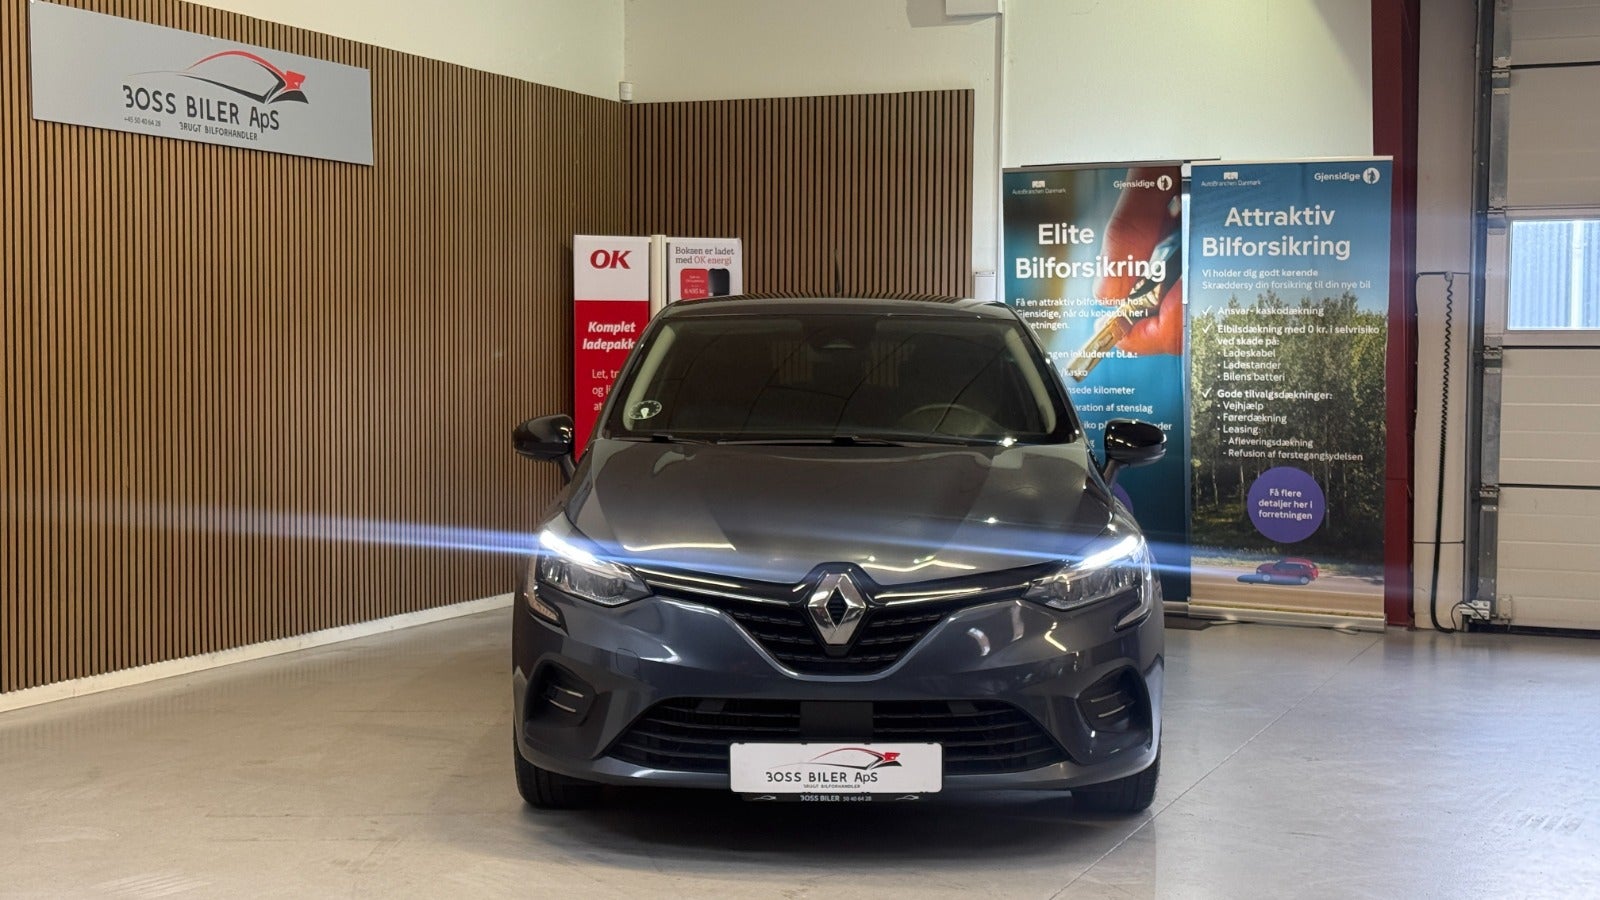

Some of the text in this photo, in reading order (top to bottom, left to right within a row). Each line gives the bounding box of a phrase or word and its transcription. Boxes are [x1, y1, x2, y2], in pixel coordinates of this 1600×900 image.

[186, 95, 240, 125] BILER
[249, 106, 280, 133] ApS
[204, 125, 258, 141] BILFORHANDLER
[1314, 172, 1361, 182] Gjensidige
[1113, 179, 1155, 190] Gjensidige
[1224, 204, 1336, 227] Attraktiv
[1038, 222, 1095, 245] Elite
[675, 246, 703, 255] Boksen
[1202, 235, 1351, 261] Bilforsikring
[590, 249, 632, 270] OK
[675, 256, 732, 266] med OK energi
[1015, 254, 1167, 283] Bilforsikring
[1212, 269, 1242, 277] holder
[1243, 269, 1257, 279] dig
[1259, 269, 1280, 279] godt
[1202, 280, 1371, 291] Skræddersy din forsikring til din nye bil
[1015, 297, 1025, 307] Få
[1039, 298, 1075, 307] attraktiv
[1076, 297, 1126, 308] bilforsikring
[1128, 297, 1144, 306] hos
[1063, 309, 1077, 318] når
[1078, 310, 1089, 318] du
[1129, 308, 1144, 317] her
[1256, 306, 1325, 317] kaskodækning
[588, 321, 636, 336] Komplet
[1028, 321, 1070, 331] etningen.
[1217, 325, 1283, 336] Elbilsdækning
[1284, 325, 1306, 334] med
[1316, 326, 1328, 334] kr.
[1334, 326, 1380, 335] selvrisiko
[582, 338, 636, 352] ladepakk
[1217, 338, 1280, 347] ved skade på:
[1070, 350, 1115, 359] inkluderer
[1223, 349, 1276, 358] Ladeskabel
[1223, 361, 1282, 370] Ladestander
[592, 368, 608, 380] Let,
[1223, 372, 1286, 382] Bilens batteri
[592, 386, 604, 398] og
[1094, 386, 1136, 395] kilometer
[1217, 389, 1333, 402] Gode tilvalgsdækninger:
[1106, 403, 1115, 412] af
[1117, 404, 1153, 414] stenslag
[1222, 402, 1264, 411] Vejhjælp
[1222, 413, 1288, 424] Førerdækning
[1228, 437, 1314, 448] Afleveringsdækning
[1228, 449, 1364, 462] Refusion af førstegangsydelsen
[1269, 488, 1302, 497] Få flere
[1258, 500, 1292, 510] detaljer
[1293, 500, 1309, 509] her
[1258, 510, 1313, 521] forretningen
[808, 772, 848, 783] BILER
[854, 772, 878, 785] ApS
[820, 794, 840, 802] BILER
